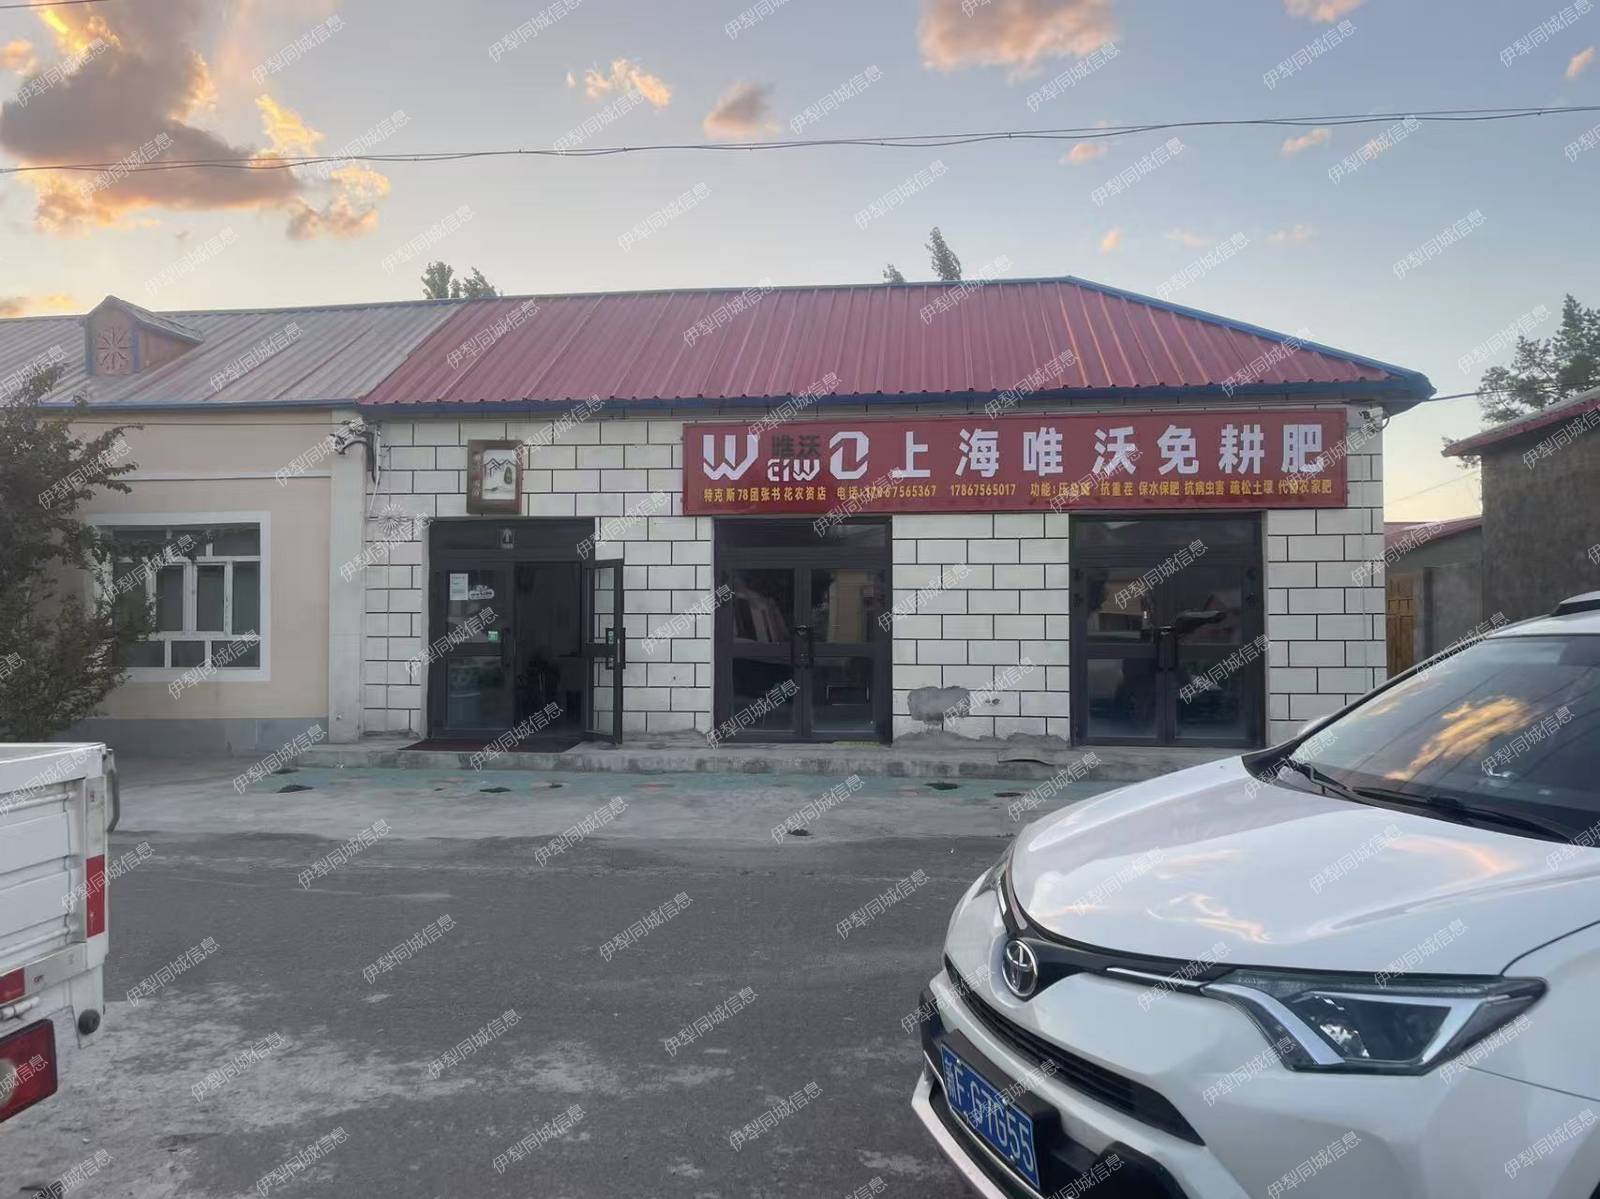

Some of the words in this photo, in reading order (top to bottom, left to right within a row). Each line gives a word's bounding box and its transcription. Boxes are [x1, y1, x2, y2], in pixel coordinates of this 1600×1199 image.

[772, 434, 821, 458] 唯沃
[894, 424, 1323, 478] 上海唯沃免耕肥
[950, 483, 1016, 496] 17867565017
[1139, 480, 1180, 496] 保水保肥
[1184, 480, 1224, 496] 抗病虫害
